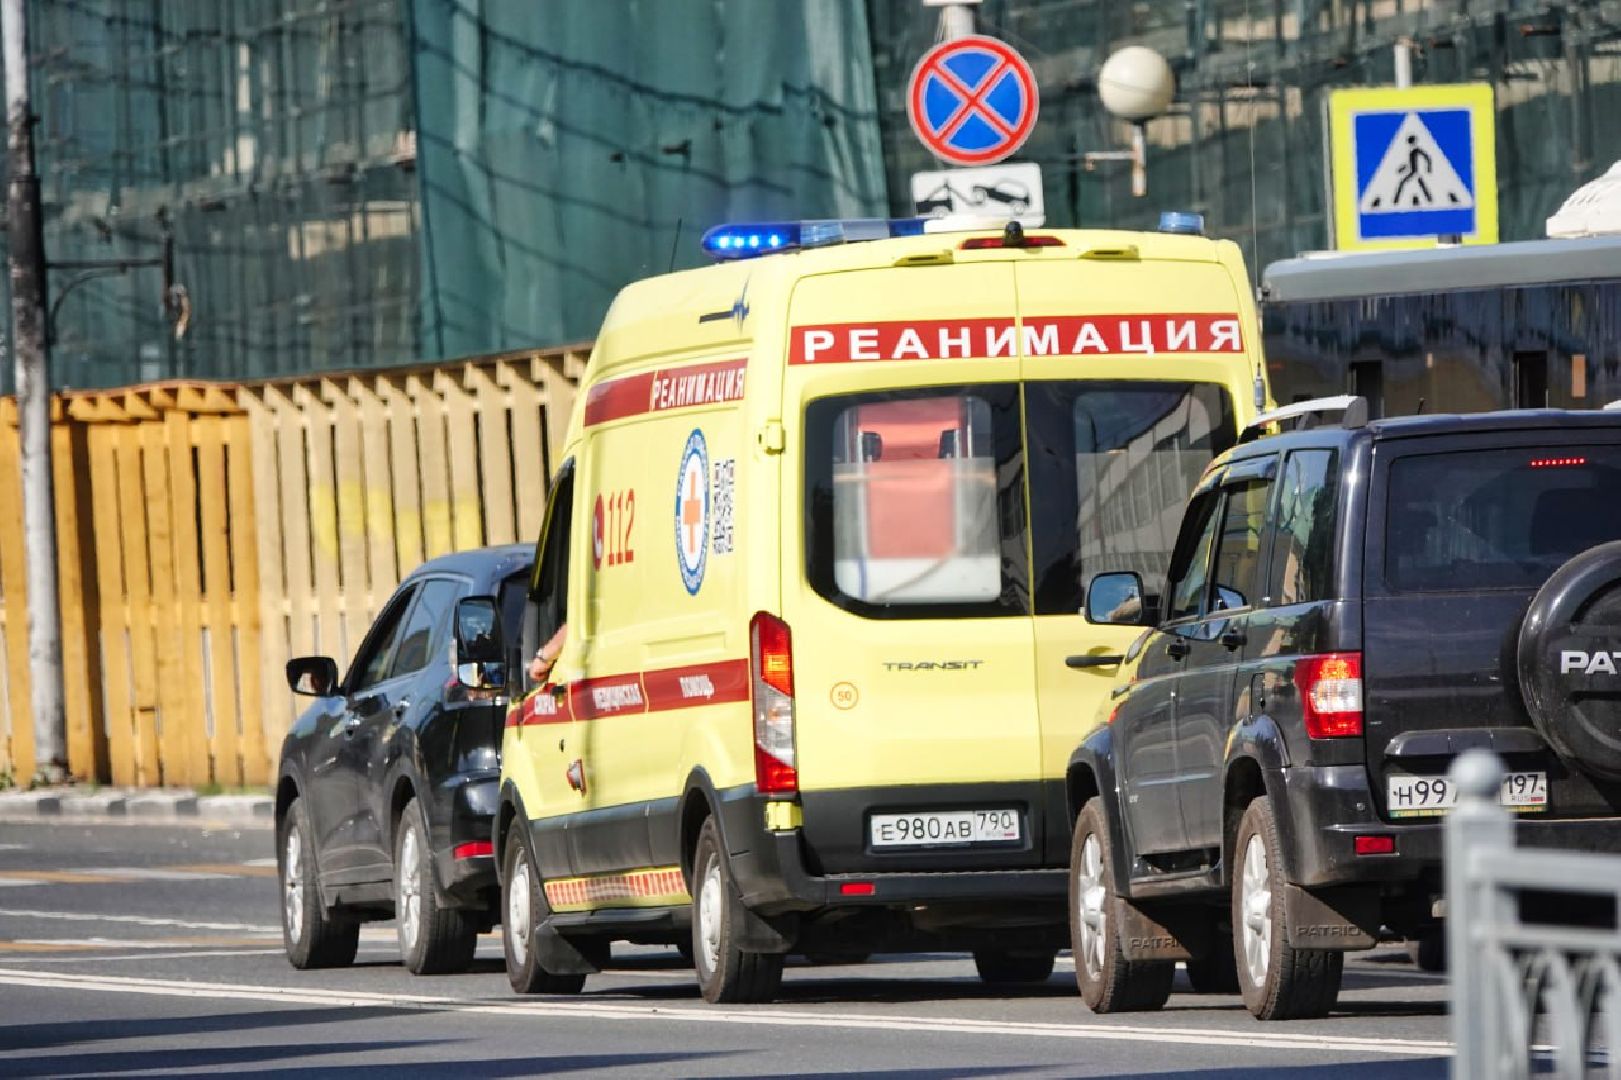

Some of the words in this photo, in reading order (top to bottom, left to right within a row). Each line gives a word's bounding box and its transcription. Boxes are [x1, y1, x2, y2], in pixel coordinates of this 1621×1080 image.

[804, 320, 1241, 361] РЕАНИМАЦИЯ
[653, 368, 745, 408] РЕАНИМАЦИЯ
[607, 488, 636, 567] 112
[882, 660, 984, 671] TRANSIT
[1398, 779, 1458, 806] Н99
[1503, 774, 1538, 794] 197
[976, 811, 1012, 830] 790
[1130, 936, 1179, 949] PATRI
[1297, 926, 1365, 937] PATRIO
